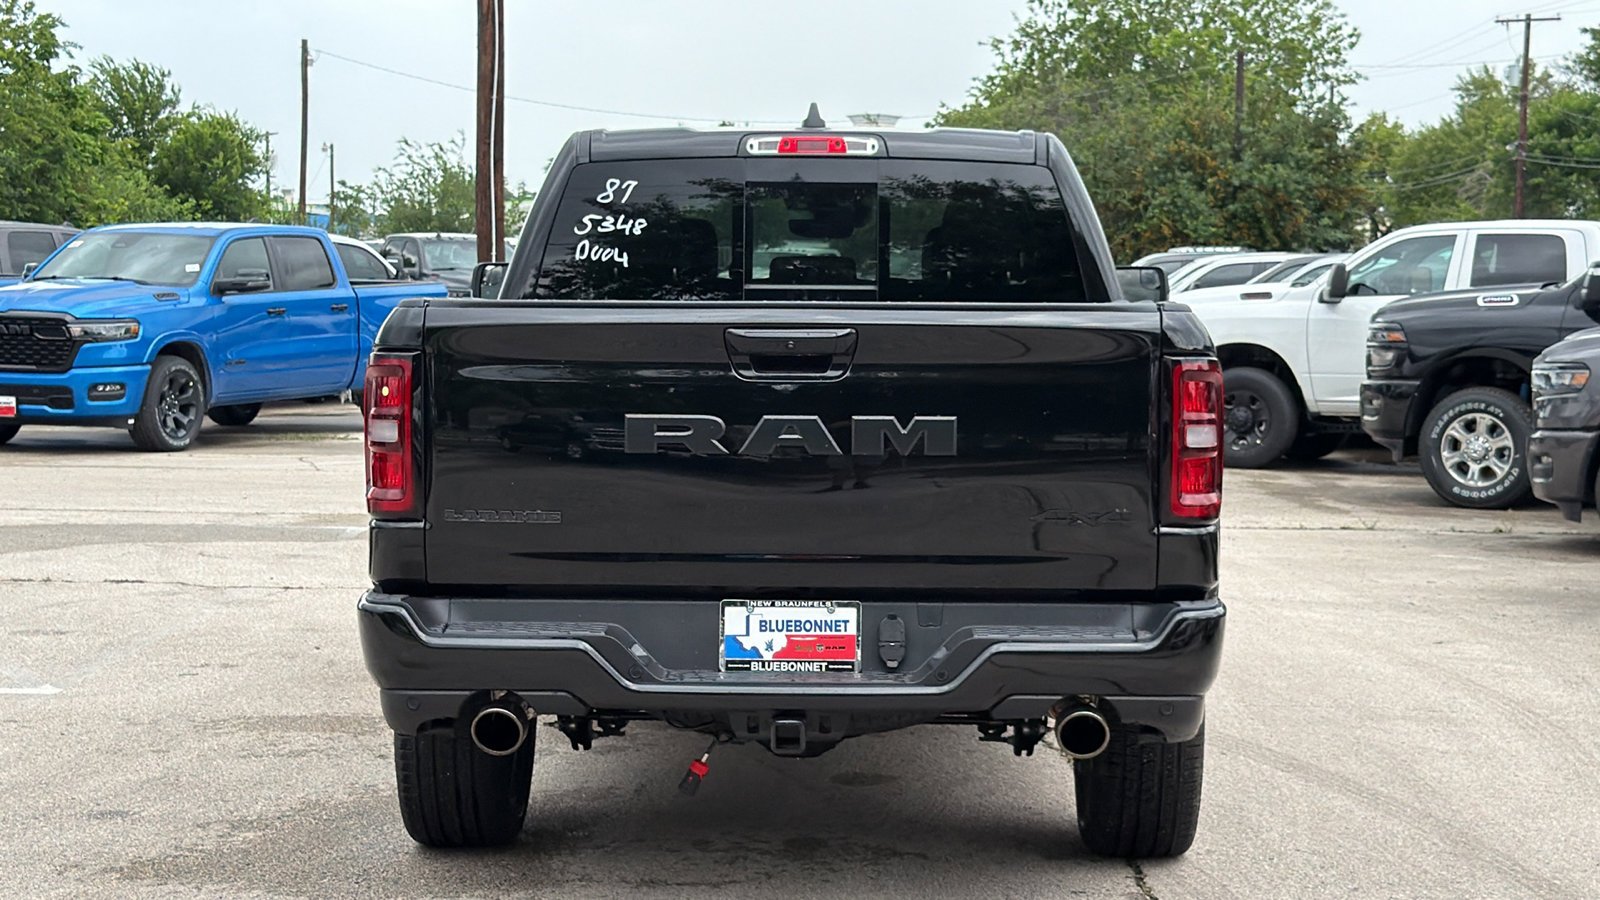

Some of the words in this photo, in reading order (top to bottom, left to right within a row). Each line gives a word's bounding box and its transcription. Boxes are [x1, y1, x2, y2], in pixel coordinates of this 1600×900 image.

[596, 178, 639, 204] 87
[574, 214, 648, 236] 5348
[624, 413, 958, 456] RAM
[774, 600, 832, 608] BRAUNFELS
[759, 619, 850, 633] BLUEBONNET
[750, 661, 828, 672] BLUEBONNET
